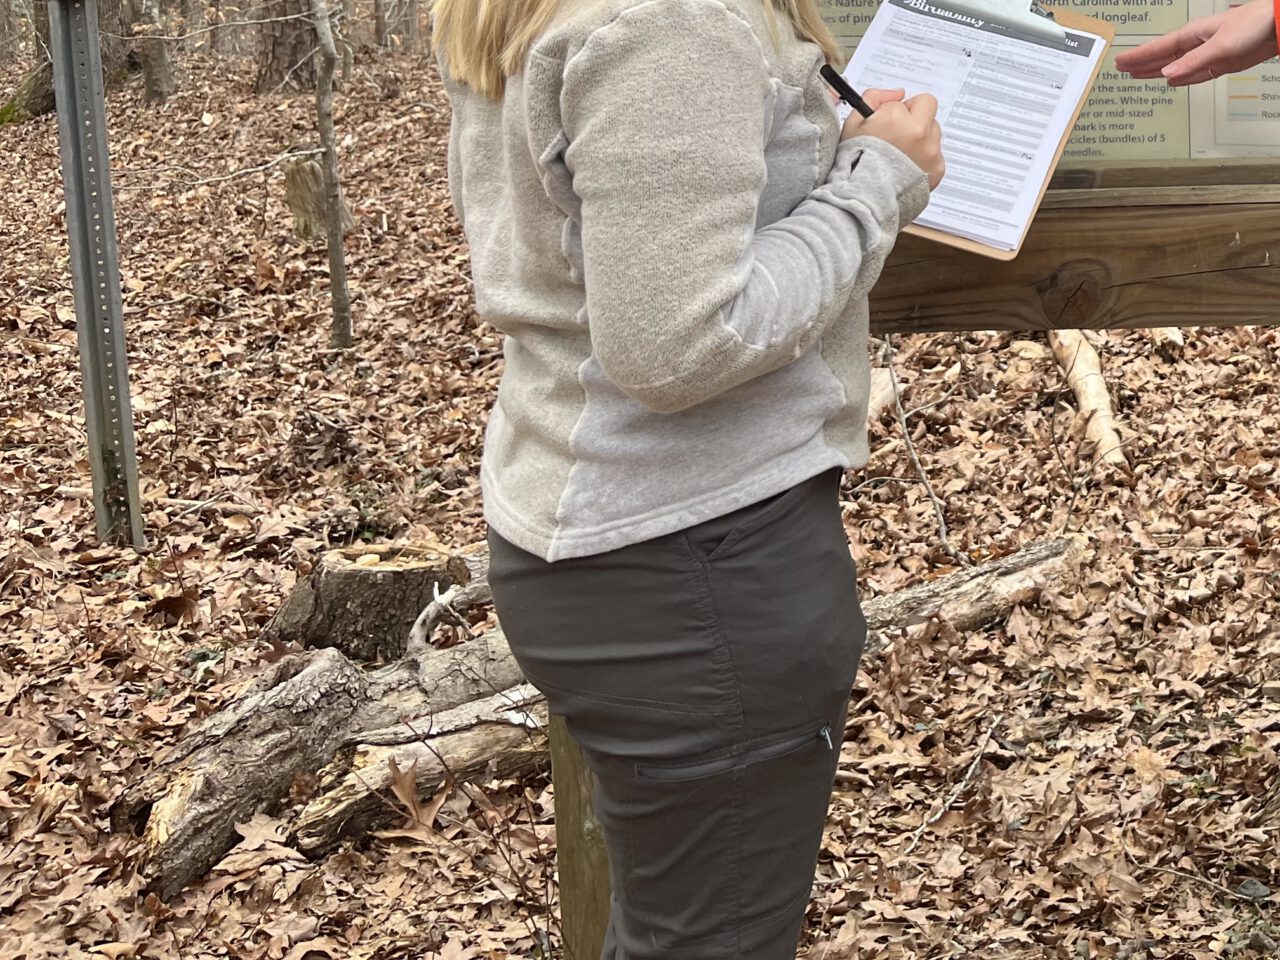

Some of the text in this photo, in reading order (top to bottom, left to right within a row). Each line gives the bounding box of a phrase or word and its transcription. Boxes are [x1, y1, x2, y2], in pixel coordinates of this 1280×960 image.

[838, 13, 850, 23] of
[1102, 12, 1152, 24] longleaf.
[1102, 72, 1119, 80] the
[1098, 84, 1114, 92] the
[1088, 96, 1173, 106] pines. White pine
[1093, 110, 1103, 118] or
[1106, 109, 1153, 118] mid-sized
[1074, 122, 1096, 131] bark
[1099, 122, 1106, 130] is
[1099, 134, 1145, 144] (bundles)
[1148, 134, 1158, 142] of
[1160, 134, 1166, 142] 5
[1064, 148, 1104, 156] needles.
